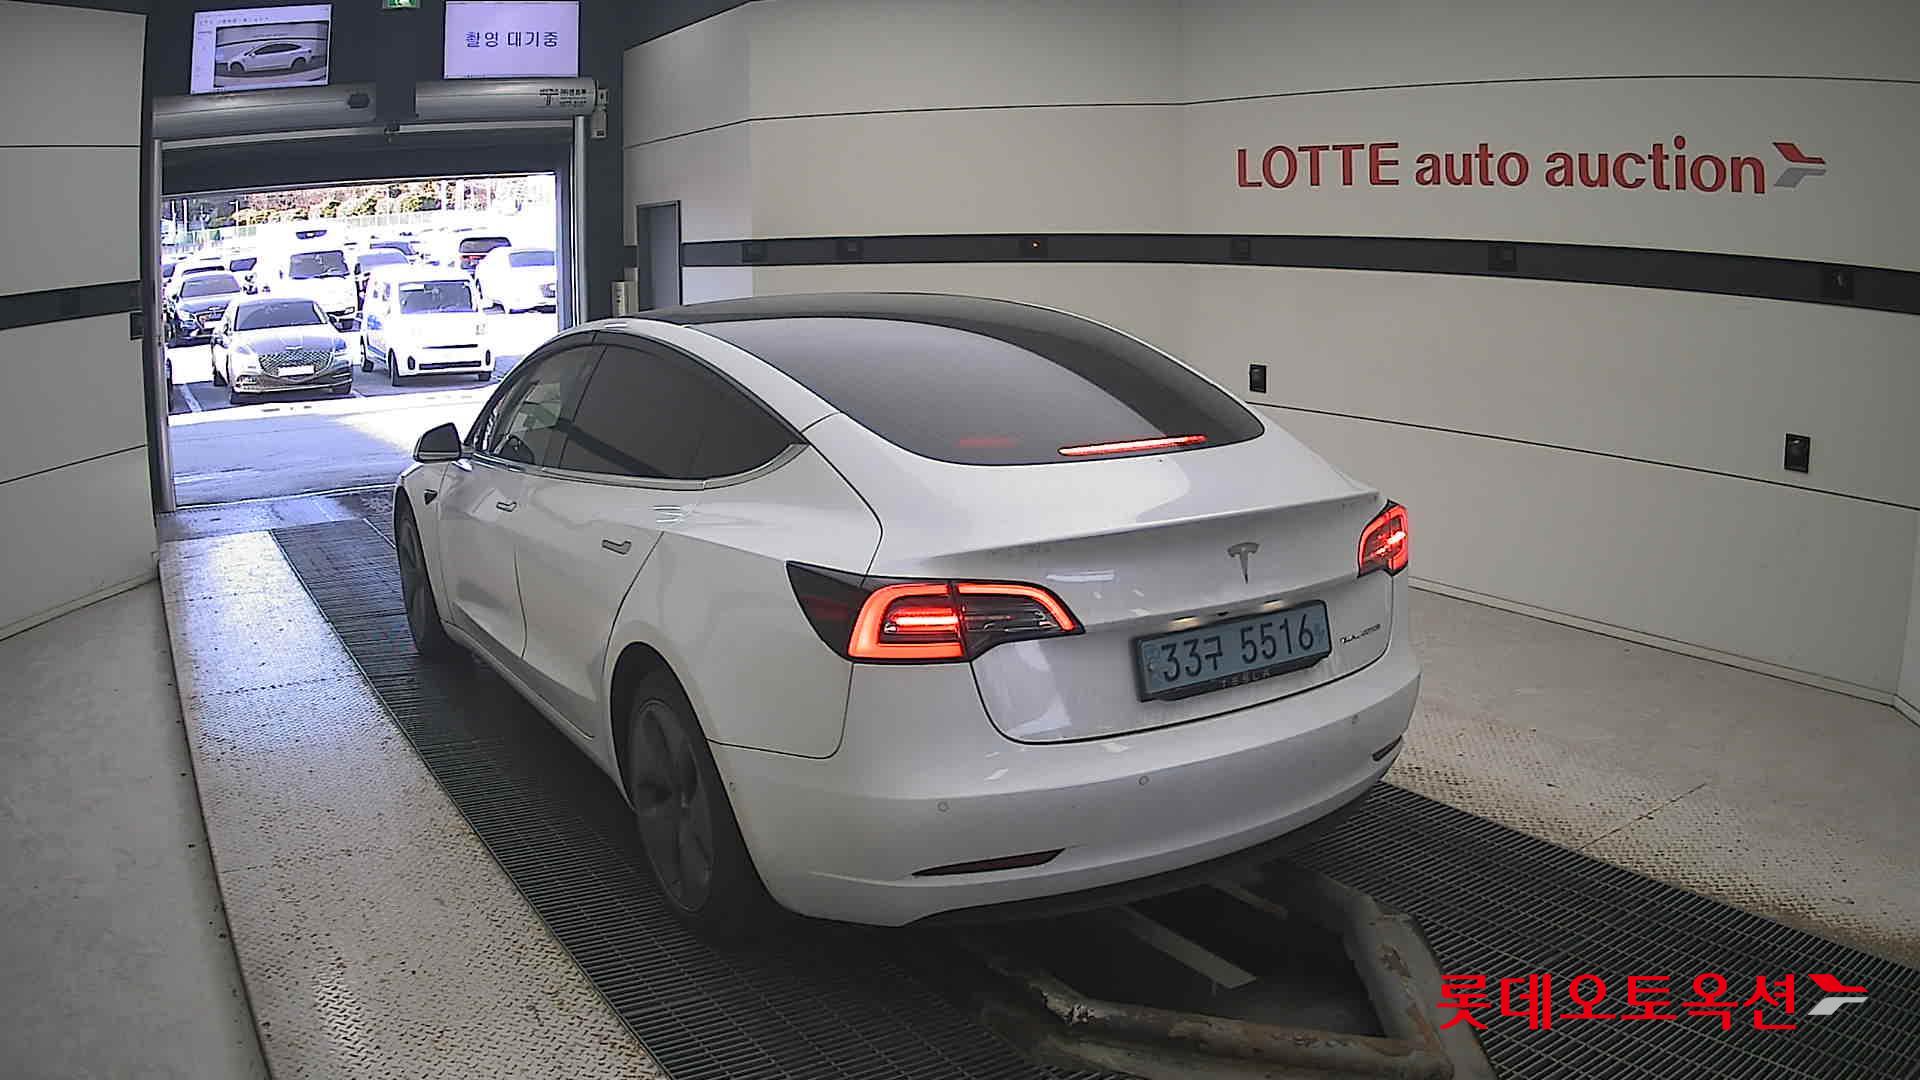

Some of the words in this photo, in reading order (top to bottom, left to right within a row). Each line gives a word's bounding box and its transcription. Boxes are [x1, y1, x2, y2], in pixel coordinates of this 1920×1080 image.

[507, 31, 559, 48] 대기중
[1237, 142, 1400, 188] LOTTE
[1416, 143, 1529, 187] auto
[1545, 136, 1766, 194] auction
[1161, 636, 1223, 682] 33구
[1240, 613, 1314, 665] 5516
